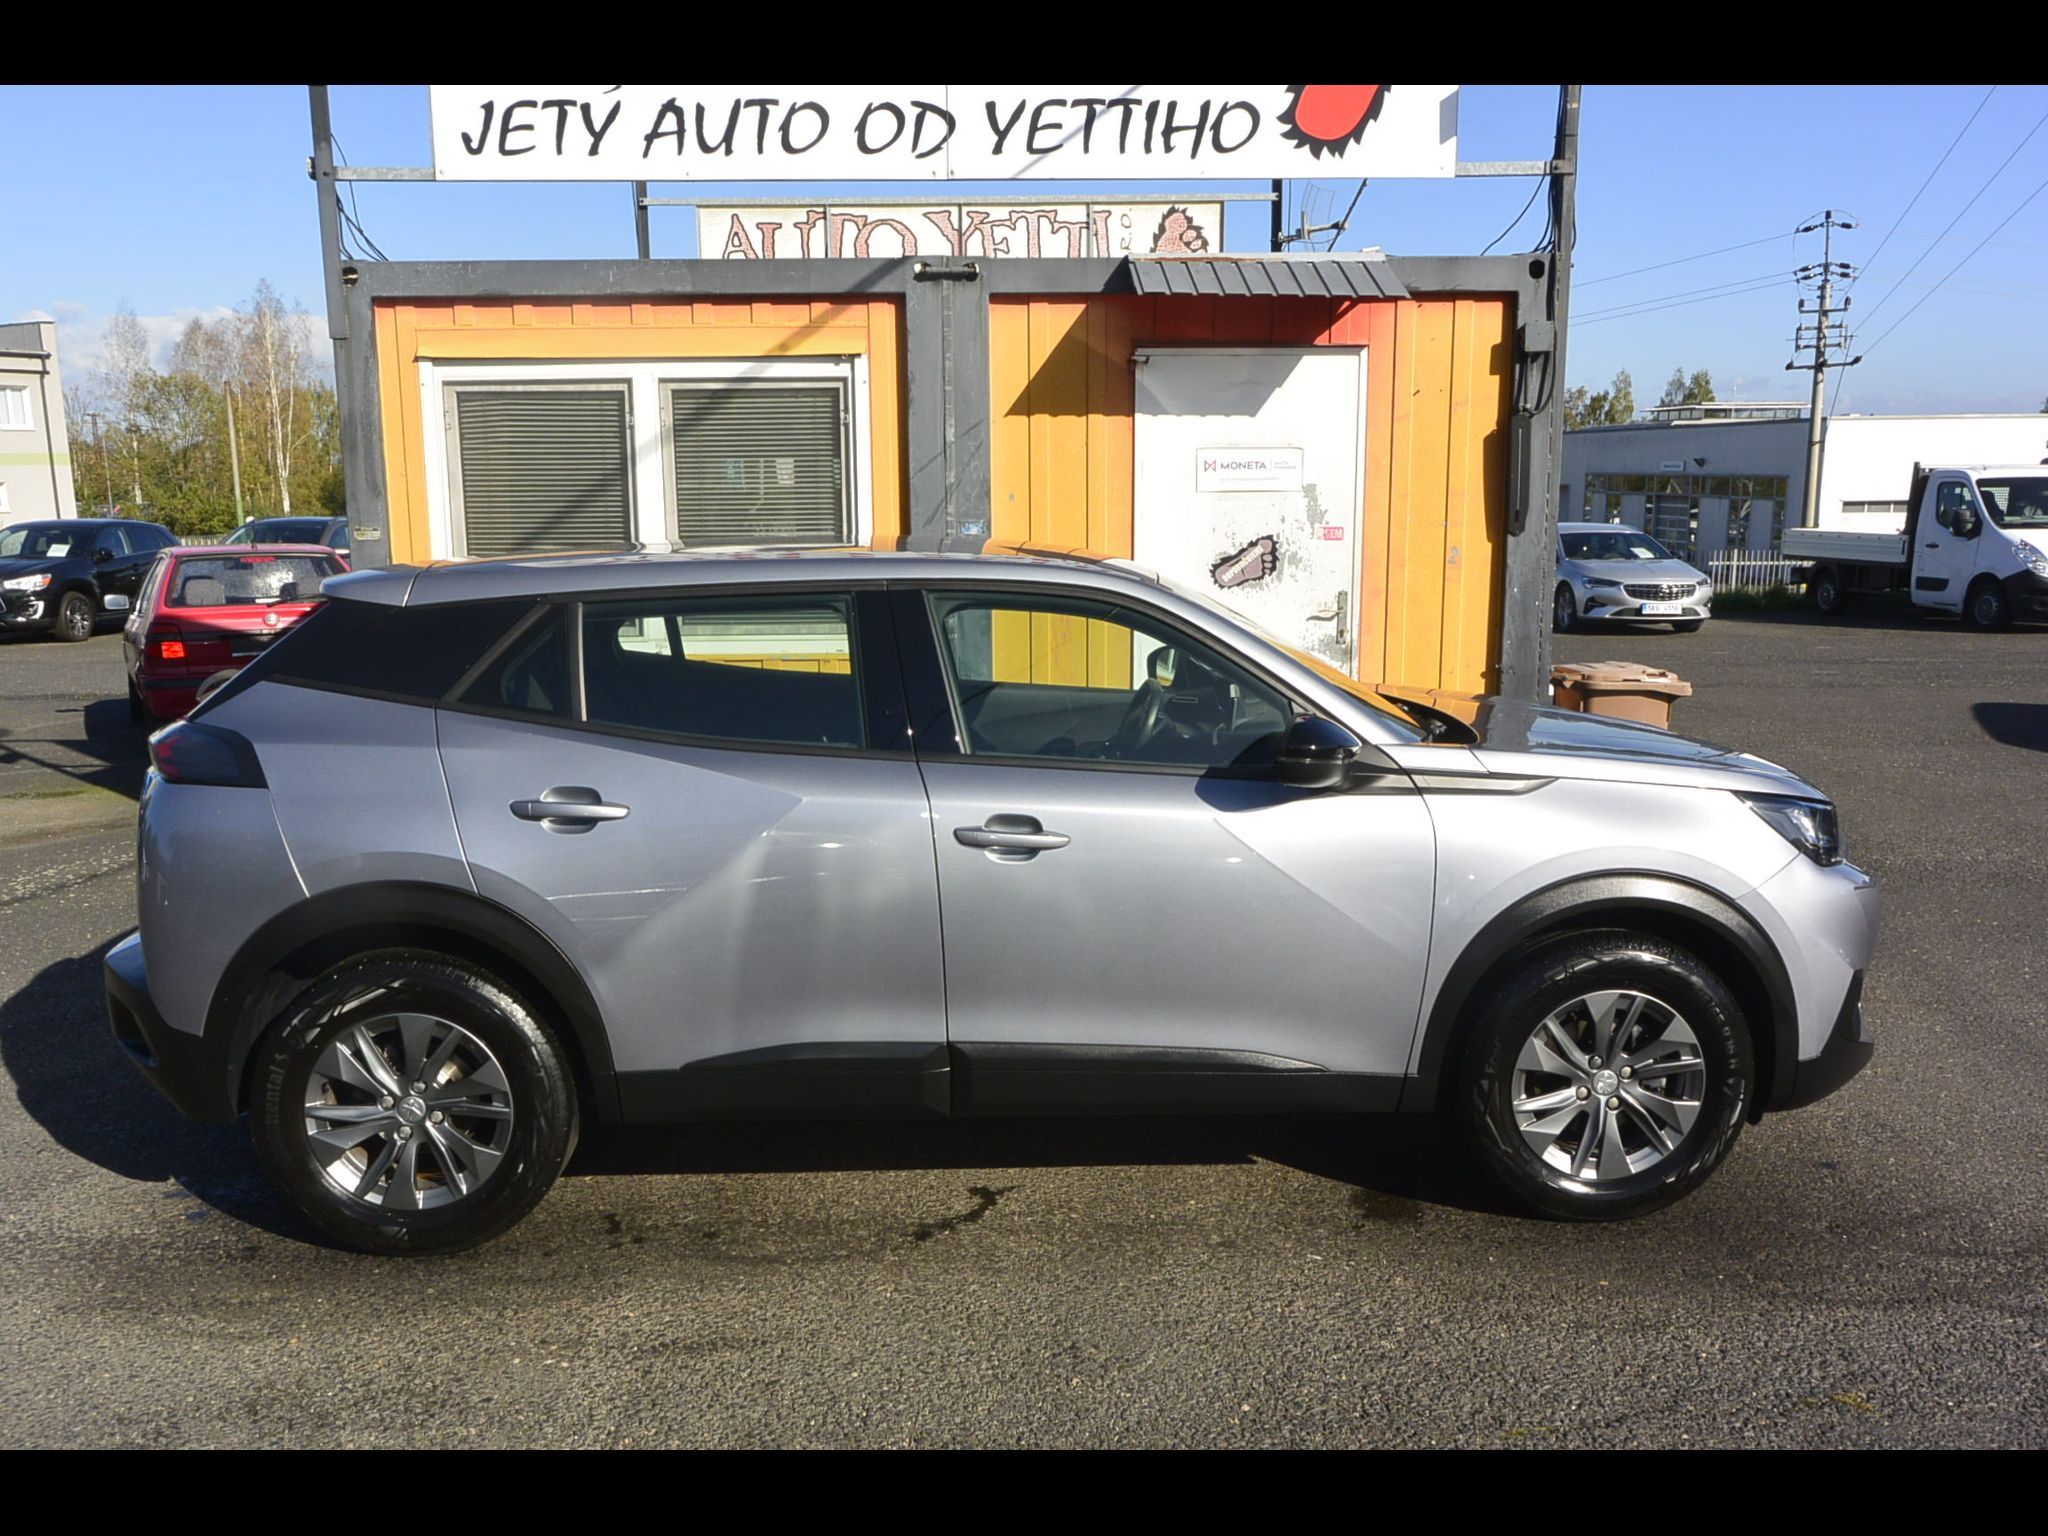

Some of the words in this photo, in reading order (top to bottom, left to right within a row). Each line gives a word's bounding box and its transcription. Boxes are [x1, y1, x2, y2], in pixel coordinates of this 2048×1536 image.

[643, 98, 830, 158] AUTO
[854, 99, 956, 159] OD
[985, 97, 1260, 159] YETTIHO
[722, 209, 918, 259] AUTO
[1220, 460, 1267, 470] MONETA
